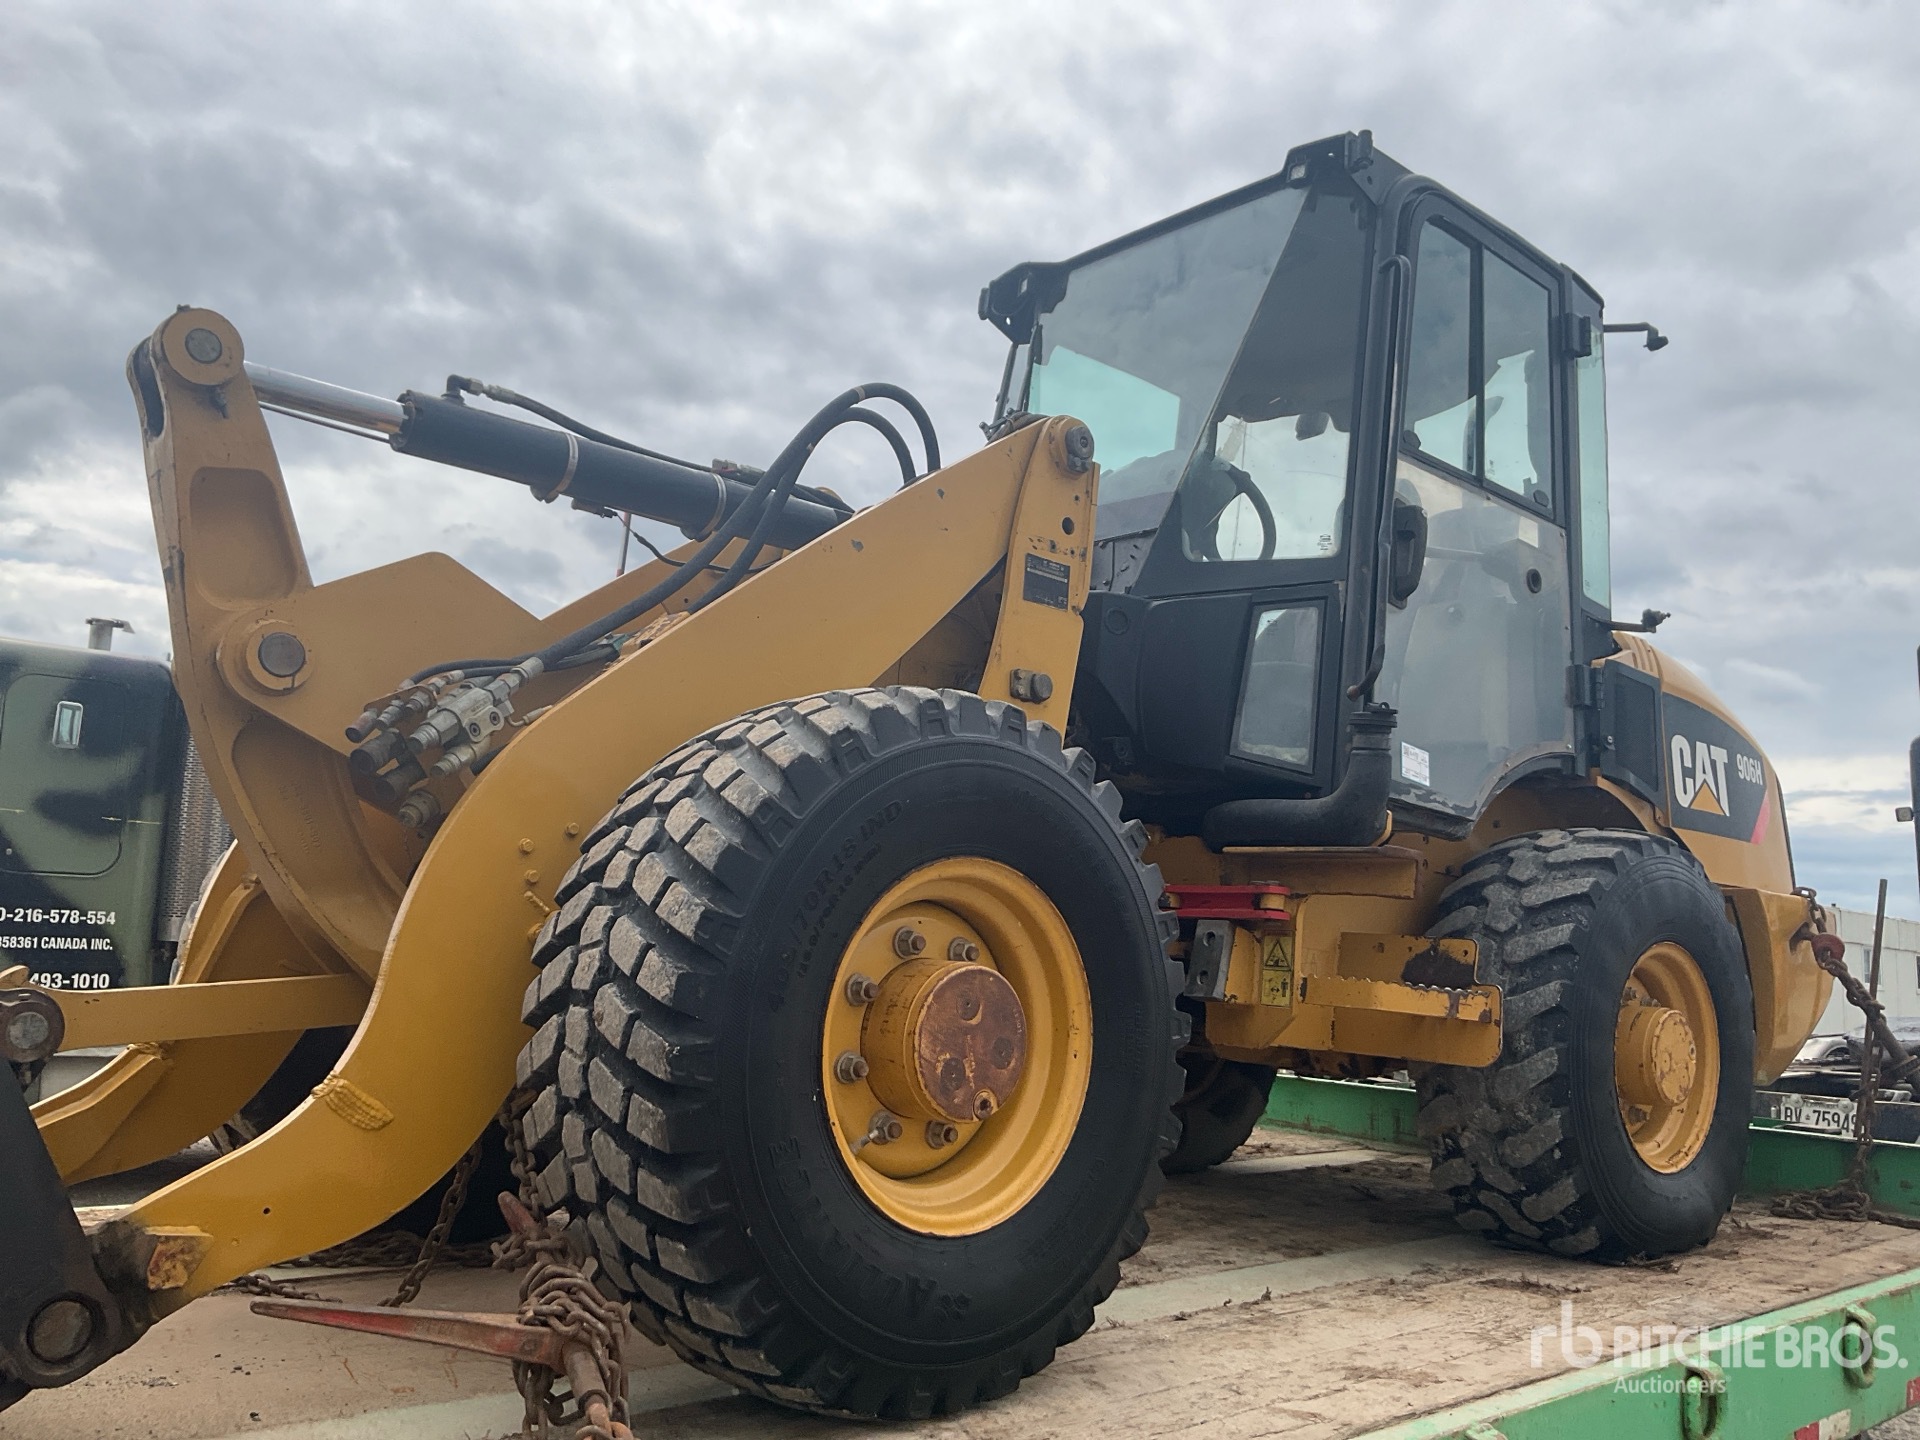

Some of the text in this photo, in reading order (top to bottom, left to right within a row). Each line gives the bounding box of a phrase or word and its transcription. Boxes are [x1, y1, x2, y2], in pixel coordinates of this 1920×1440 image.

[1671, 734, 1730, 817] CAT
[1736, 753, 1763, 786] 906H
[41, 936, 88, 950] CANADA
[90, 938, 113, 951] INC.
